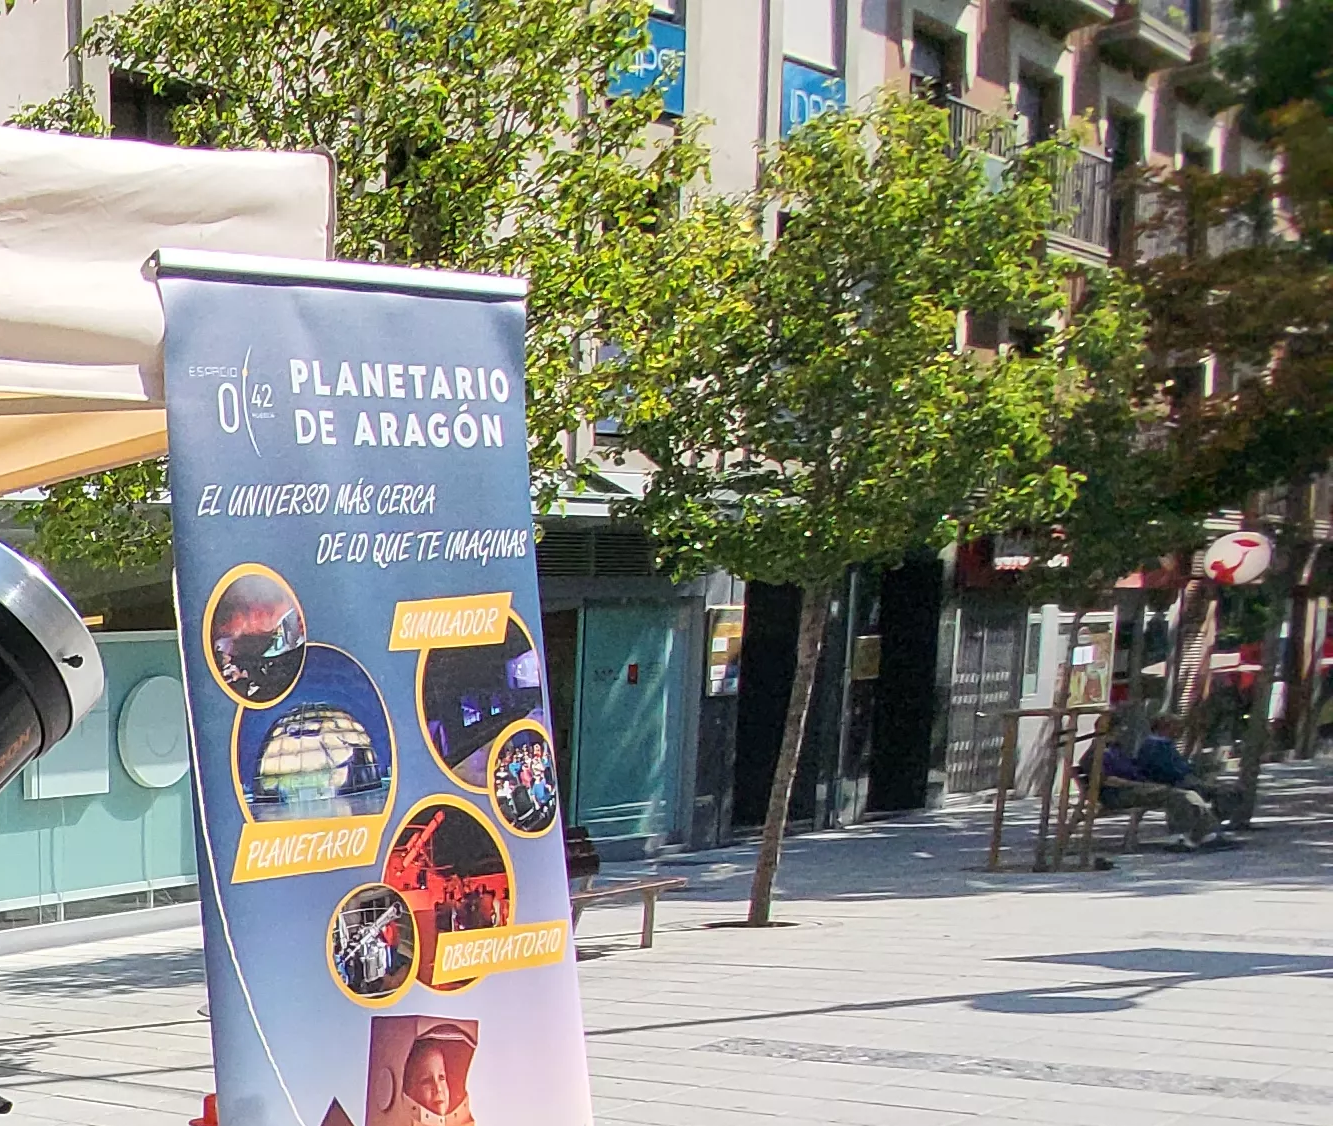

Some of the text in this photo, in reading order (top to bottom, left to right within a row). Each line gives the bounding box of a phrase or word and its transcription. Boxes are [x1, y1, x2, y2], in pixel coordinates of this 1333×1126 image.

[289, 358, 510, 403] PLANETARIO
[294, 402, 505, 449] DE ARAGÓN
[197, 477, 436, 518] EL UNIVERSO MÁS CERCA
[316, 527, 528, 568] DE LO QUE TE IMAGINAS
[398, 608, 499, 640] SIMULADOR
[245, 826, 369, 872] PLANETARIO
[441, 927, 562, 972] OBSERVATORIO
